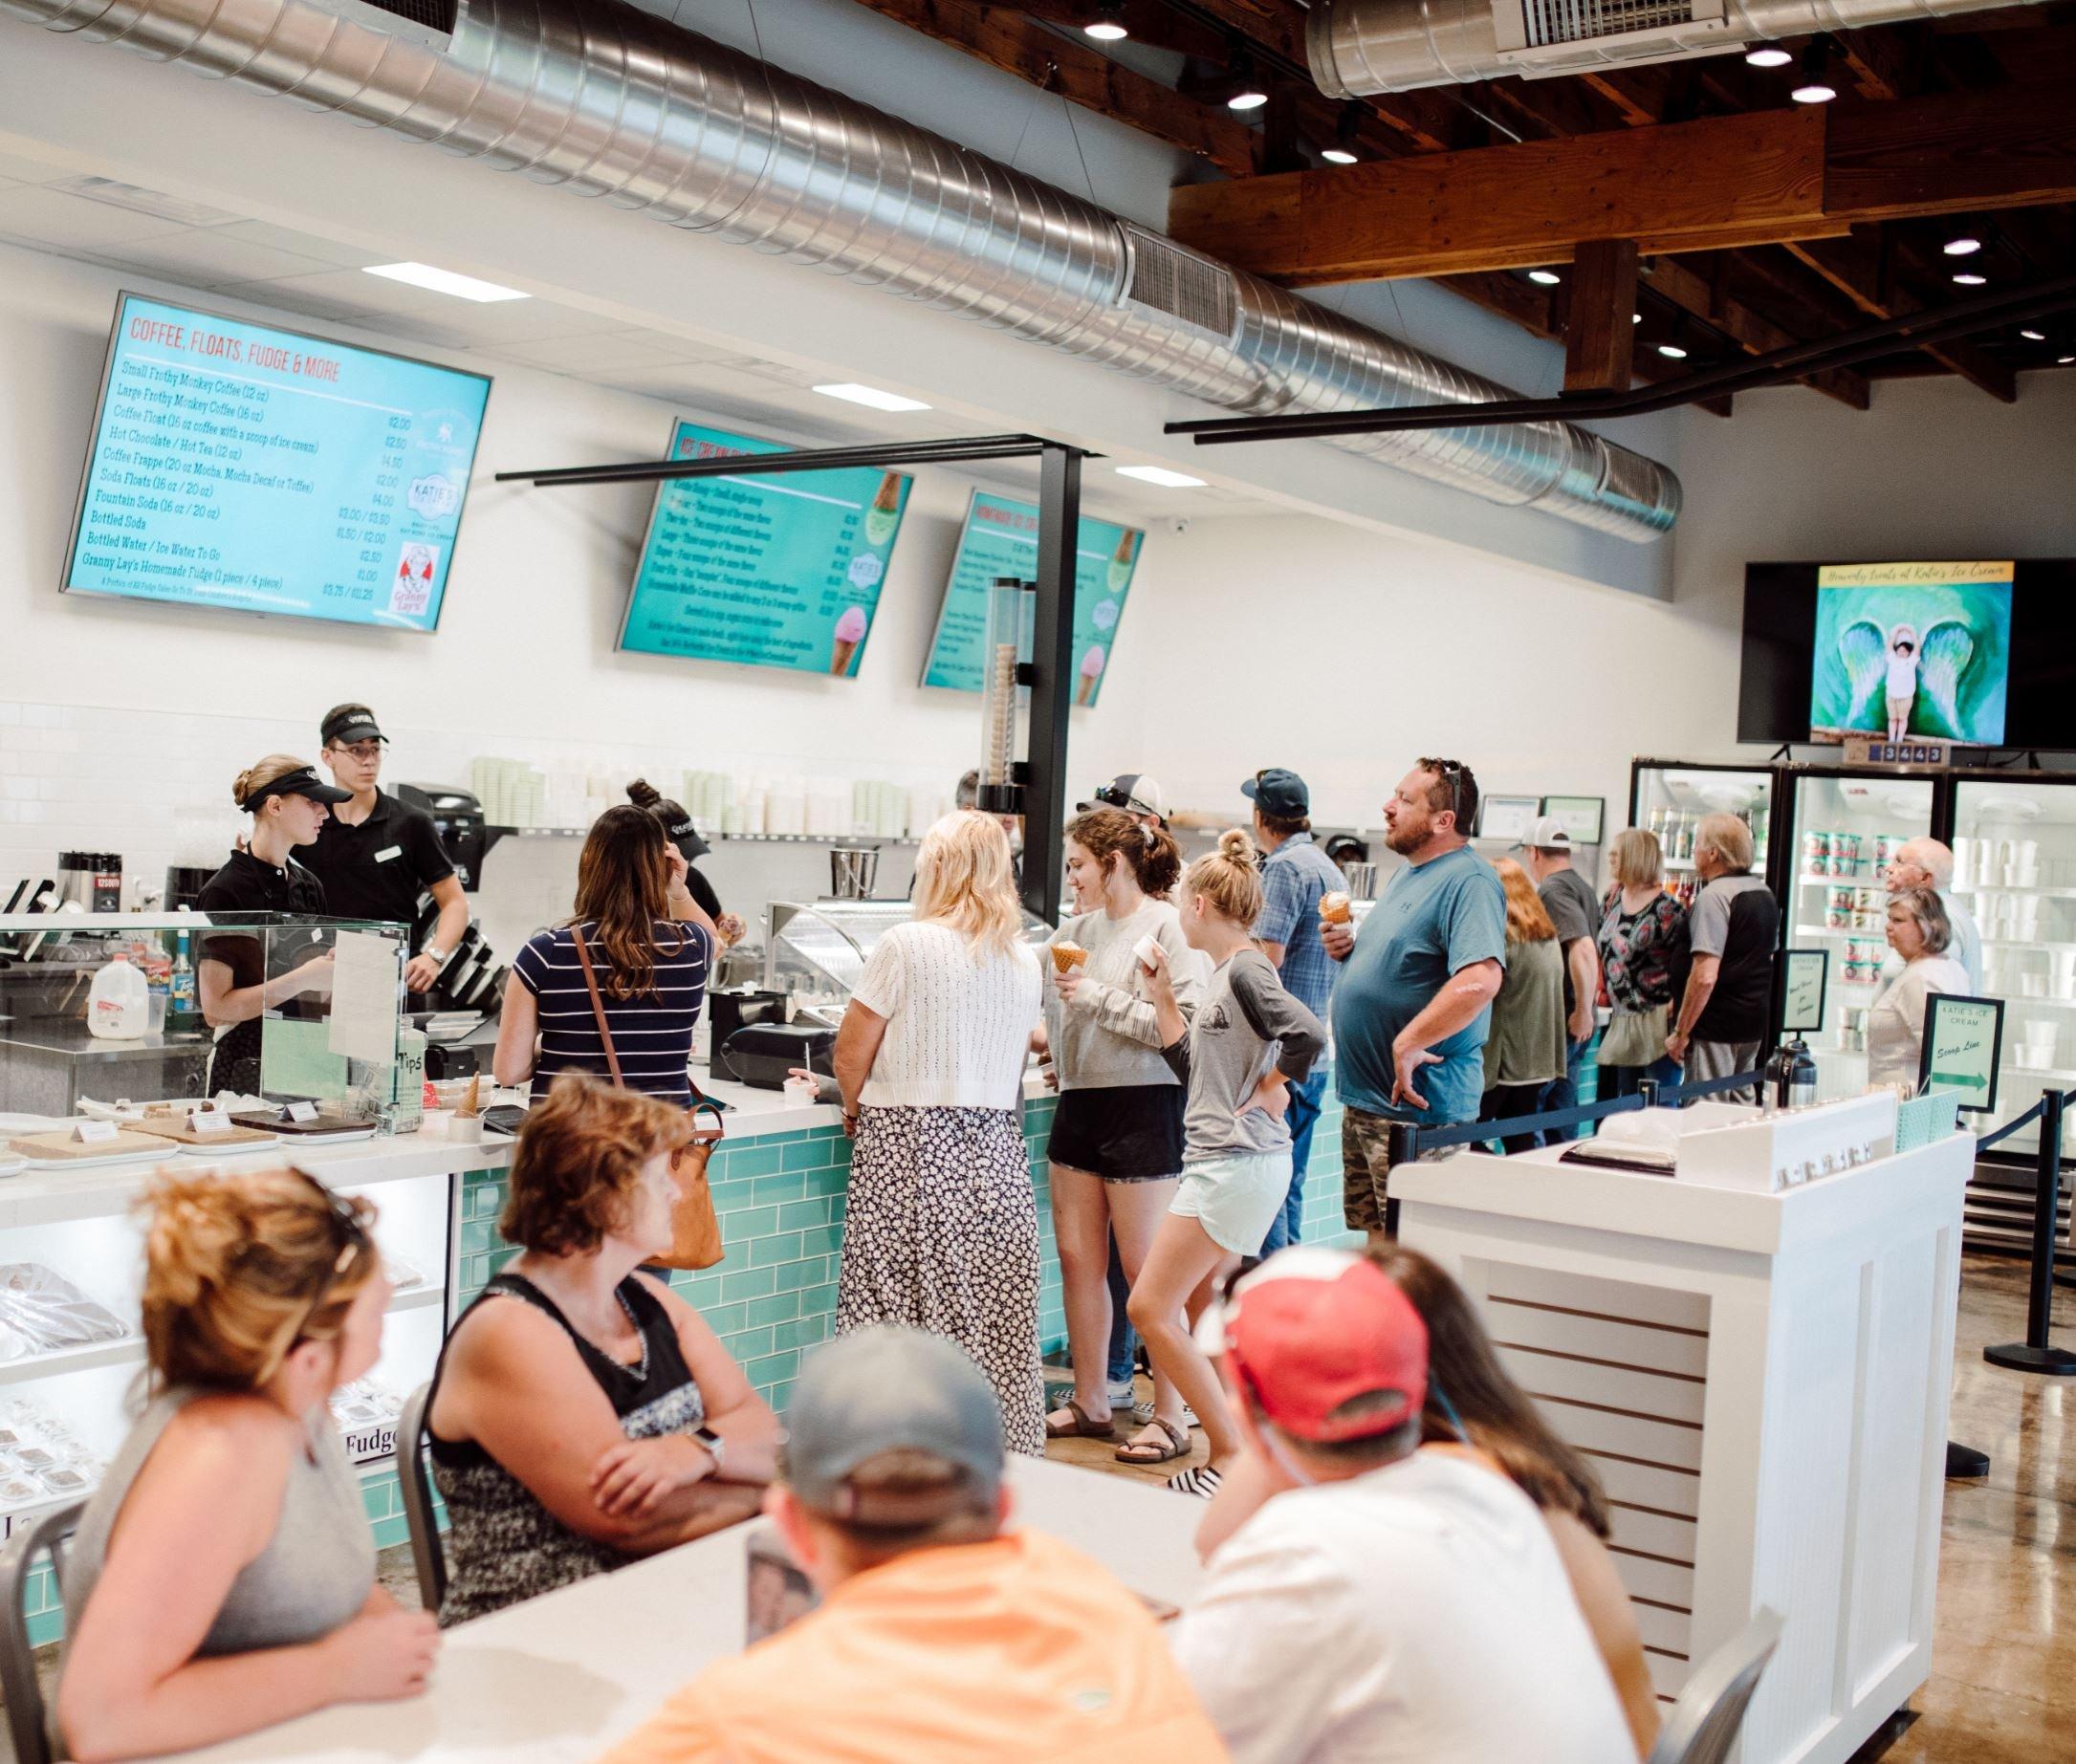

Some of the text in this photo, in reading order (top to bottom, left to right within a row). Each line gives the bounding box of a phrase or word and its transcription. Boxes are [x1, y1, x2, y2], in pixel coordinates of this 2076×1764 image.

[130, 316, 339, 381] COFFEE, FLOATS, FUDGE & MORE
[121, 360, 148, 378] Small
[148, 366, 178, 387] Frothy
[179, 372, 214, 394] Monkey
[214, 380, 241, 396] Coffee
[117, 382, 142, 400] Large
[143, 387, 173, 408] Frothy
[173, 393, 208, 414] Monkey
[208, 401, 235, 417] Coffee
[108, 425, 127, 440] Hot
[129, 429, 171, 448] Chocolate
[179, 438, 197, 451] Hot
[198, 441, 213, 456] Tea
[113, 403, 142, 421] Coffee
[143, 409, 166, 425] Float
[183, 420, 192, 430] oz
[193, 421, 219, 434] coffee
[219, 426, 238, 438] with
[245, 431, 269, 447] scoop
[268, 434, 280, 446] of
[291, 438, 319, 454] cream)
[99, 467, 122, 483] Soda
[123, 471, 151, 488] Floats
[166, 482, 178, 492] oz
[186, 481, 199, 495] 20
[102, 446, 131, 463] Coffee
[133, 451, 164, 470] Frappe
[164, 456, 182, 471] (20
[183, 463, 192, 473] oz
[224, 467, 251, 482] Mocha
[252, 472, 277, 488] Decaf
[95, 489, 136, 507] Fountain
[137, 495, 159, 511] Soda
[174, 504, 185, 514] oz
[192, 504, 206, 517] 20
[90, 510, 146, 530] Bottled Soda
[86, 531, 120, 548] Bottled
[121, 535, 147, 551] Water
[155, 540, 169, 555] Ice
[170, 543, 195, 558] Water
[197, 546, 208, 559] To
[208, 548, 220, 561] Go
[81, 552, 115, 571] Granny
[116, 556, 139, 573] Lay's
[140, 559, 186, 577] Homemade
[187, 565, 213, 582] Fudge
[213, 569, 222, 582] (1
[221, 572, 244, 585] piece
[251, 575, 258, 586] 4
[257, 577, 282, 590] piece)
[1885, 747, 1940, 761] 3443
[1950, 1017, 1978, 1026] CREAM
[398, 1052, 422, 1075] Tips
[1936, 1040, 1981, 1059] Scoop Line
